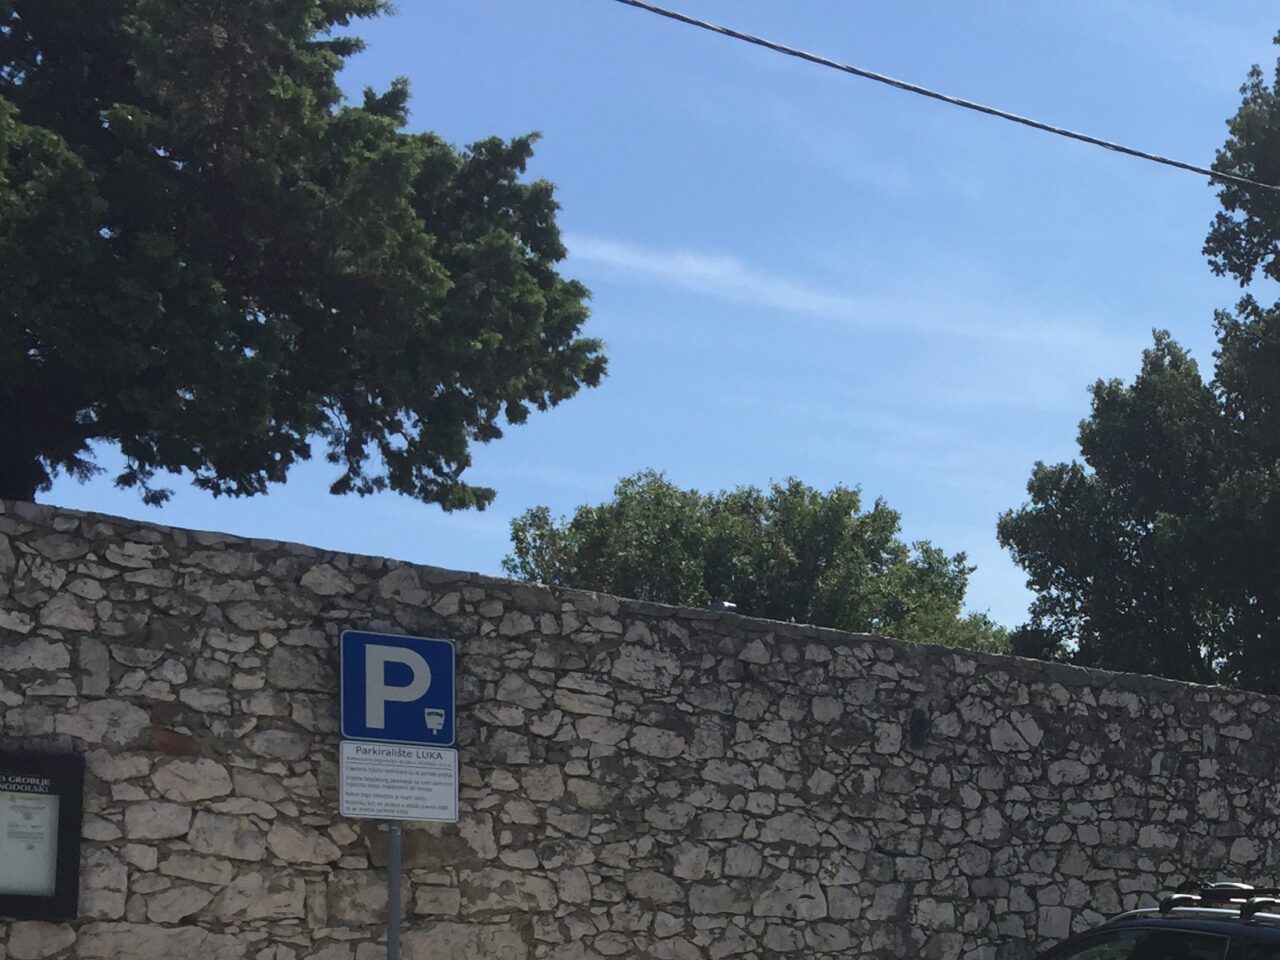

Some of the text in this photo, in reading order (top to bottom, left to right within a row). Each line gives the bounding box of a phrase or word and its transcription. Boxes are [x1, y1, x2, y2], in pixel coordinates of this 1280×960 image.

[365, 643, 432, 729] P
[355, 745, 443, 761] Parkiralište LUKA
